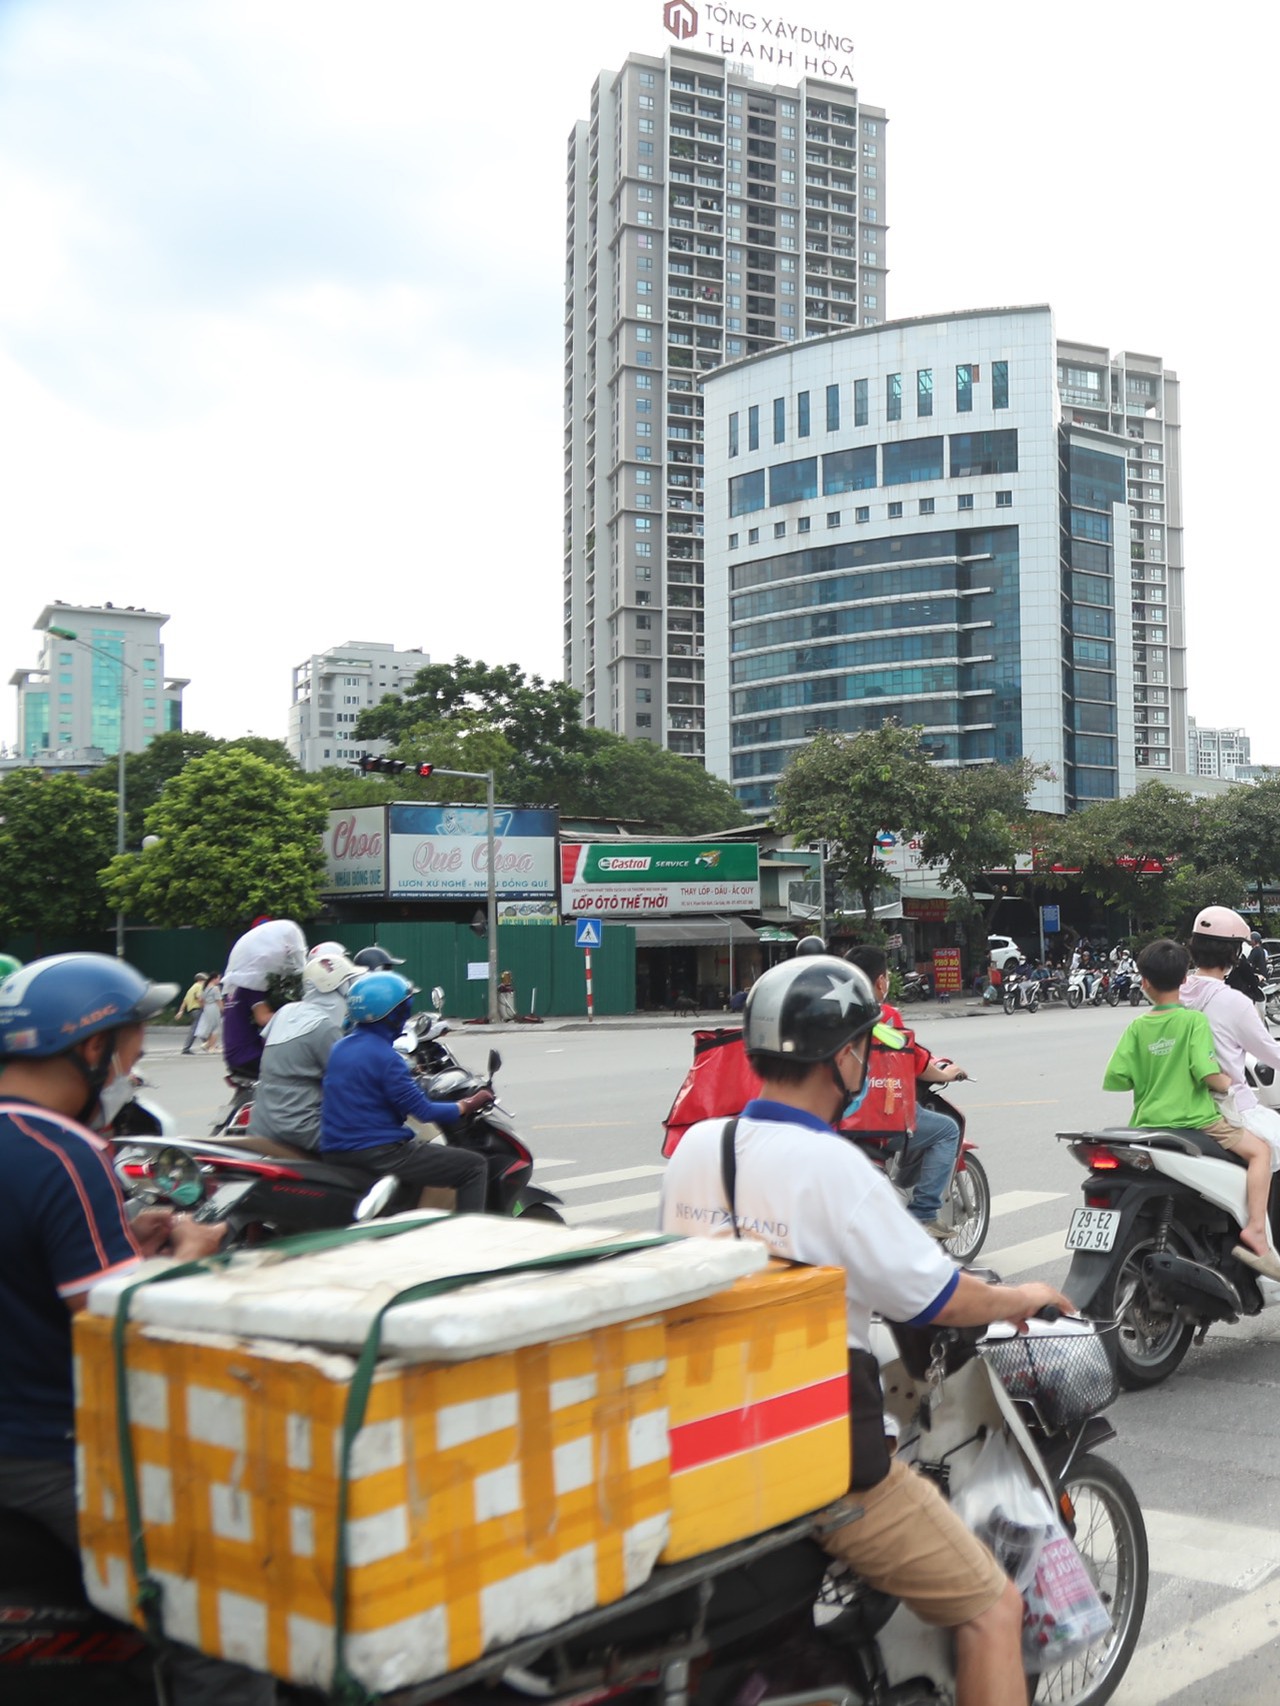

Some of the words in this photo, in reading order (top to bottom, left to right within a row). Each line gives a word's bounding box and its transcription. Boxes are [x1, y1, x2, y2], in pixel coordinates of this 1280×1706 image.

[706, 32, 793, 67] THANH
[333, 815, 383, 860] Choa
[413, 840, 463, 877] Quê
[611, 859, 647, 869] Castrol
[572, 894, 593, 910] LỐP
[1077, 1211, 1112, 1230] 29-E2
[1069, 1230, 1110, 1249] 467.94
